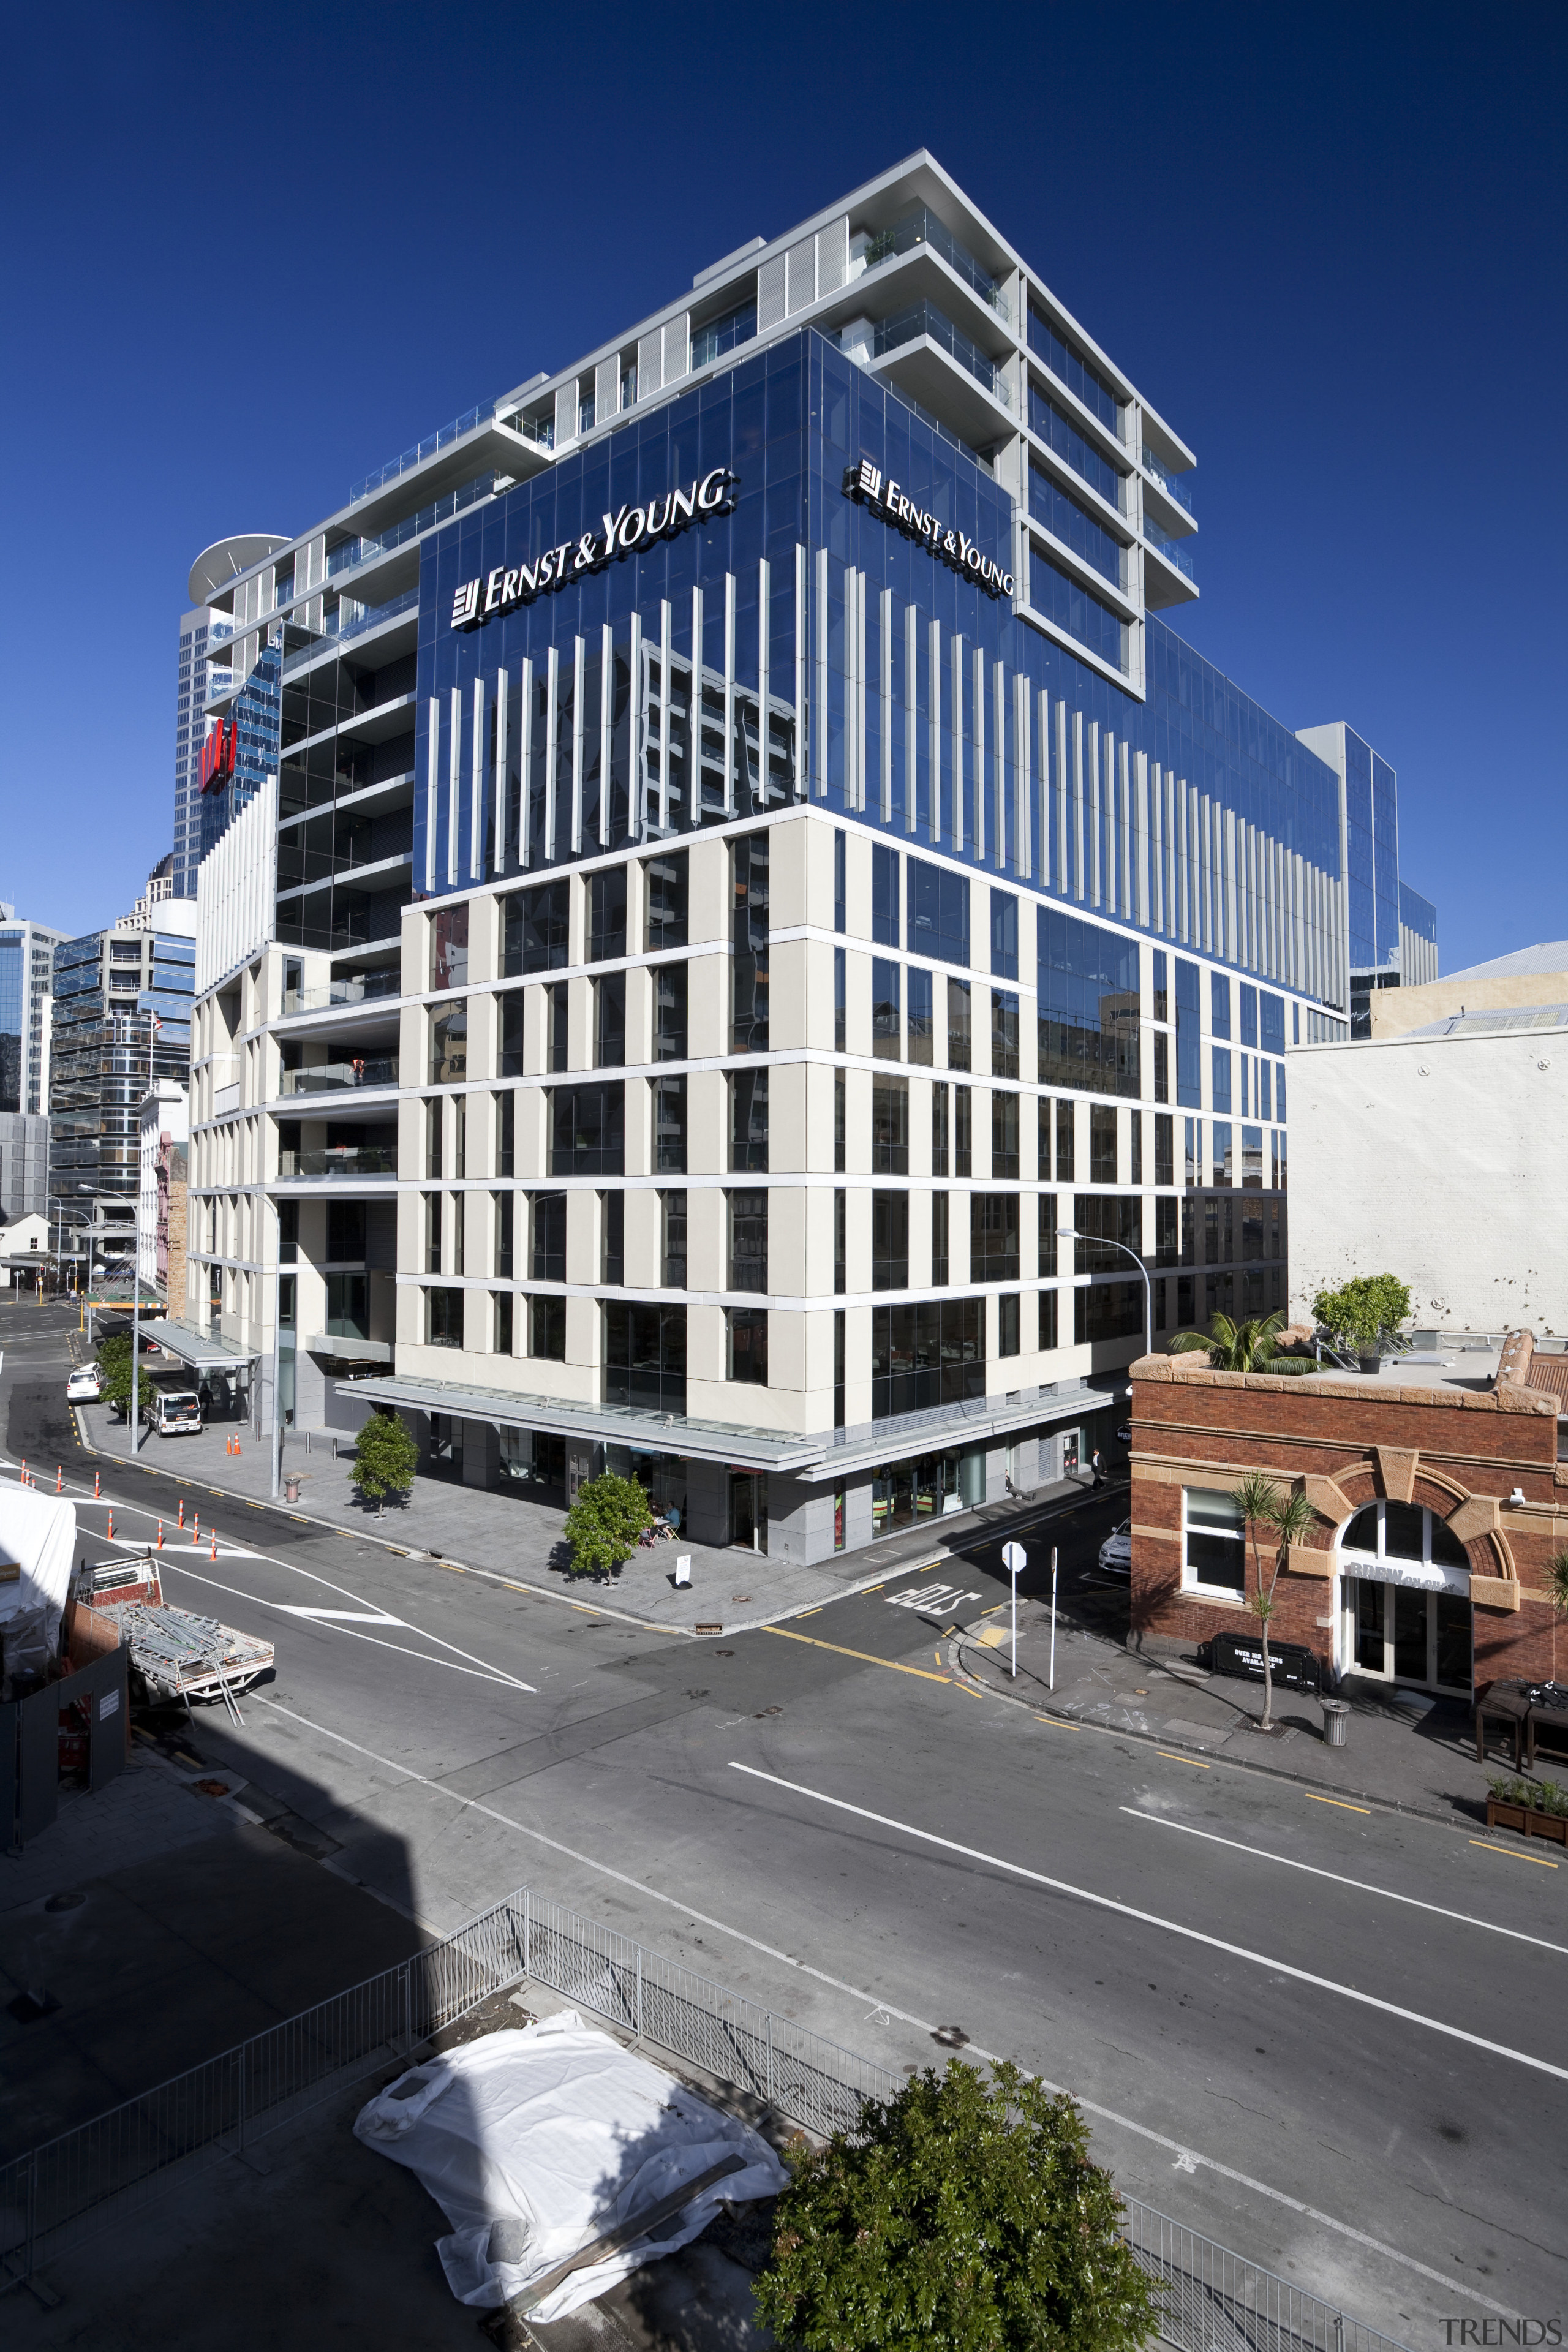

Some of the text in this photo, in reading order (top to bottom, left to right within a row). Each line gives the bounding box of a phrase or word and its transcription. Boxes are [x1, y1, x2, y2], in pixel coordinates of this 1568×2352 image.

[485, 467, 728, 612] ERNST & YOUNG
[886, 479, 1014, 596] ERNST & YOUNG
[1351, 1562, 1403, 1584] BREW
[1405, 1576, 1421, 1587] ON
[883, 1583, 984, 1616] STOP
[1242, 1657, 1275, 1669] AVAILALE
[1268, 1656, 1283, 1664] EERS
